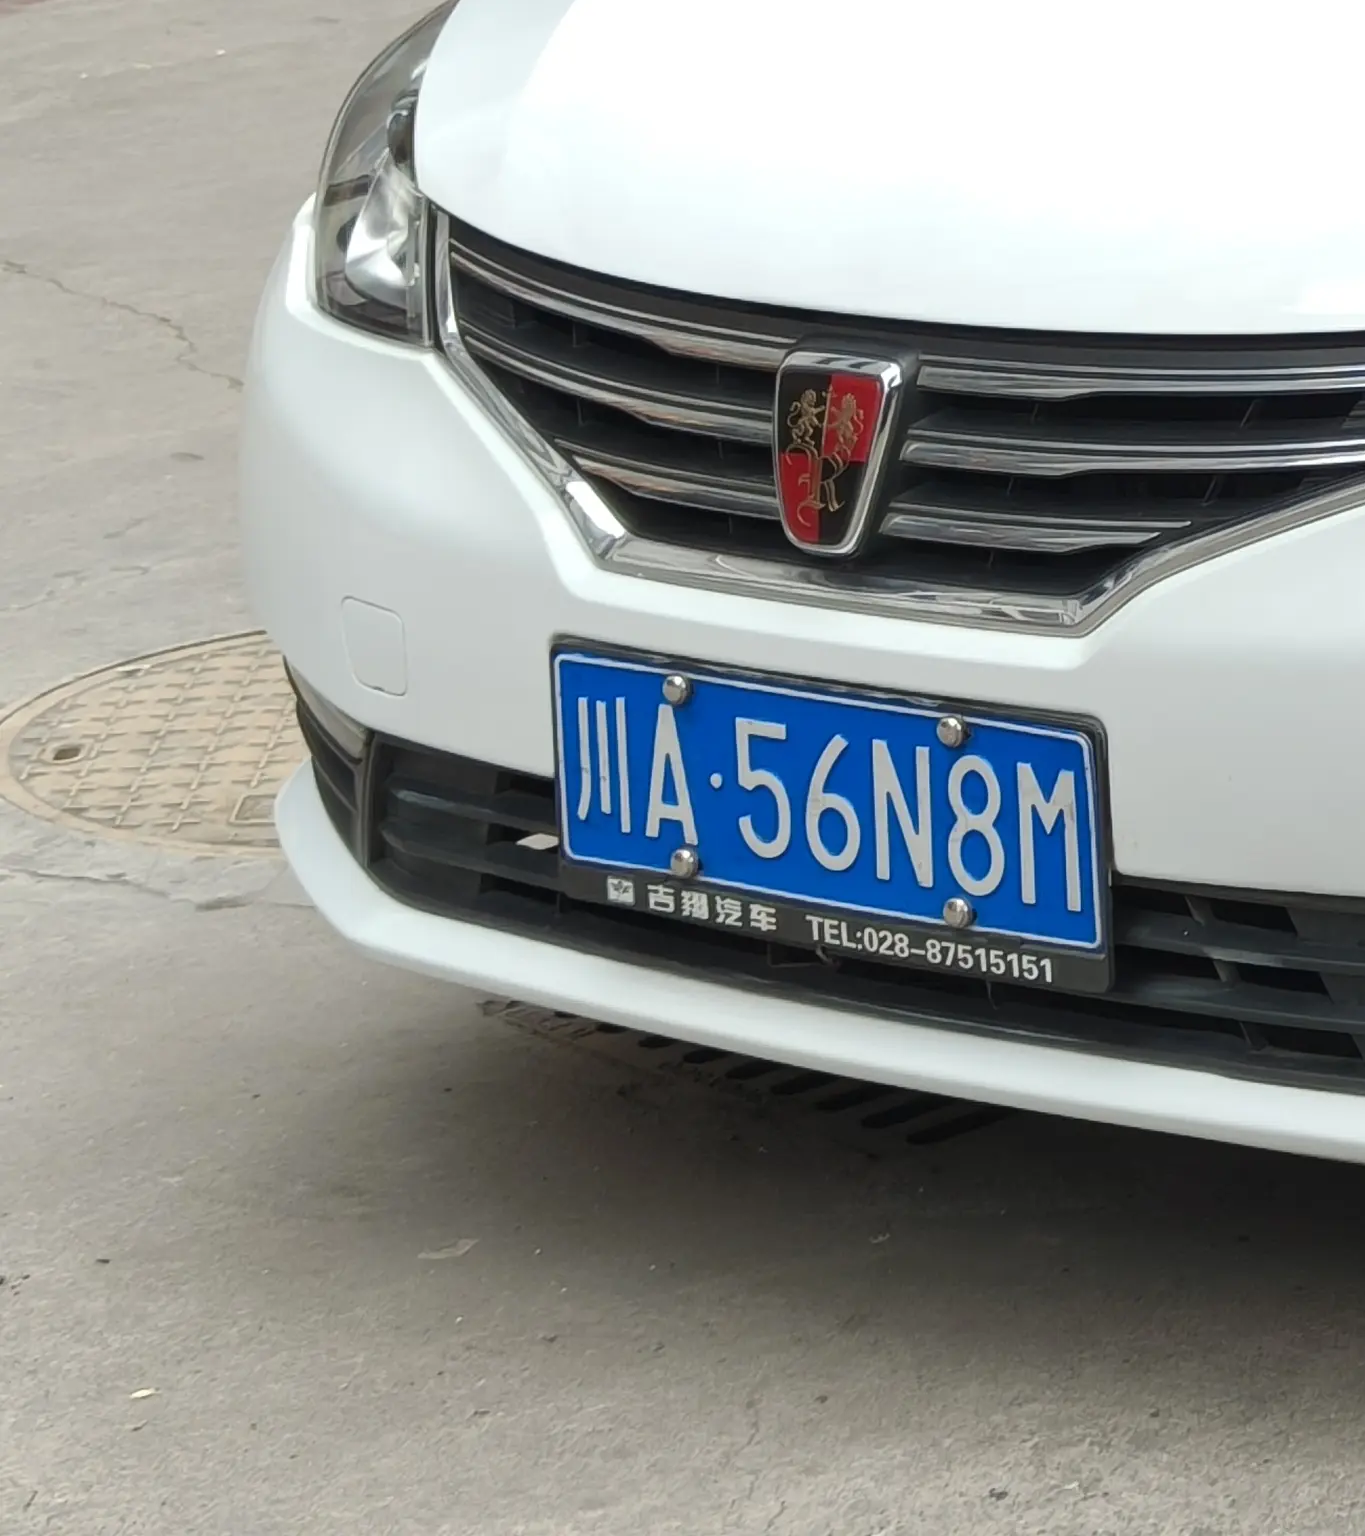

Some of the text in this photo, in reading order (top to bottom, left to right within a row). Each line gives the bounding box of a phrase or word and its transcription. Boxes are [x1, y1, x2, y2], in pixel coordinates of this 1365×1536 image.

[646, 883, 1055, 984] 吉翔汽车 TEL:028-87515151
